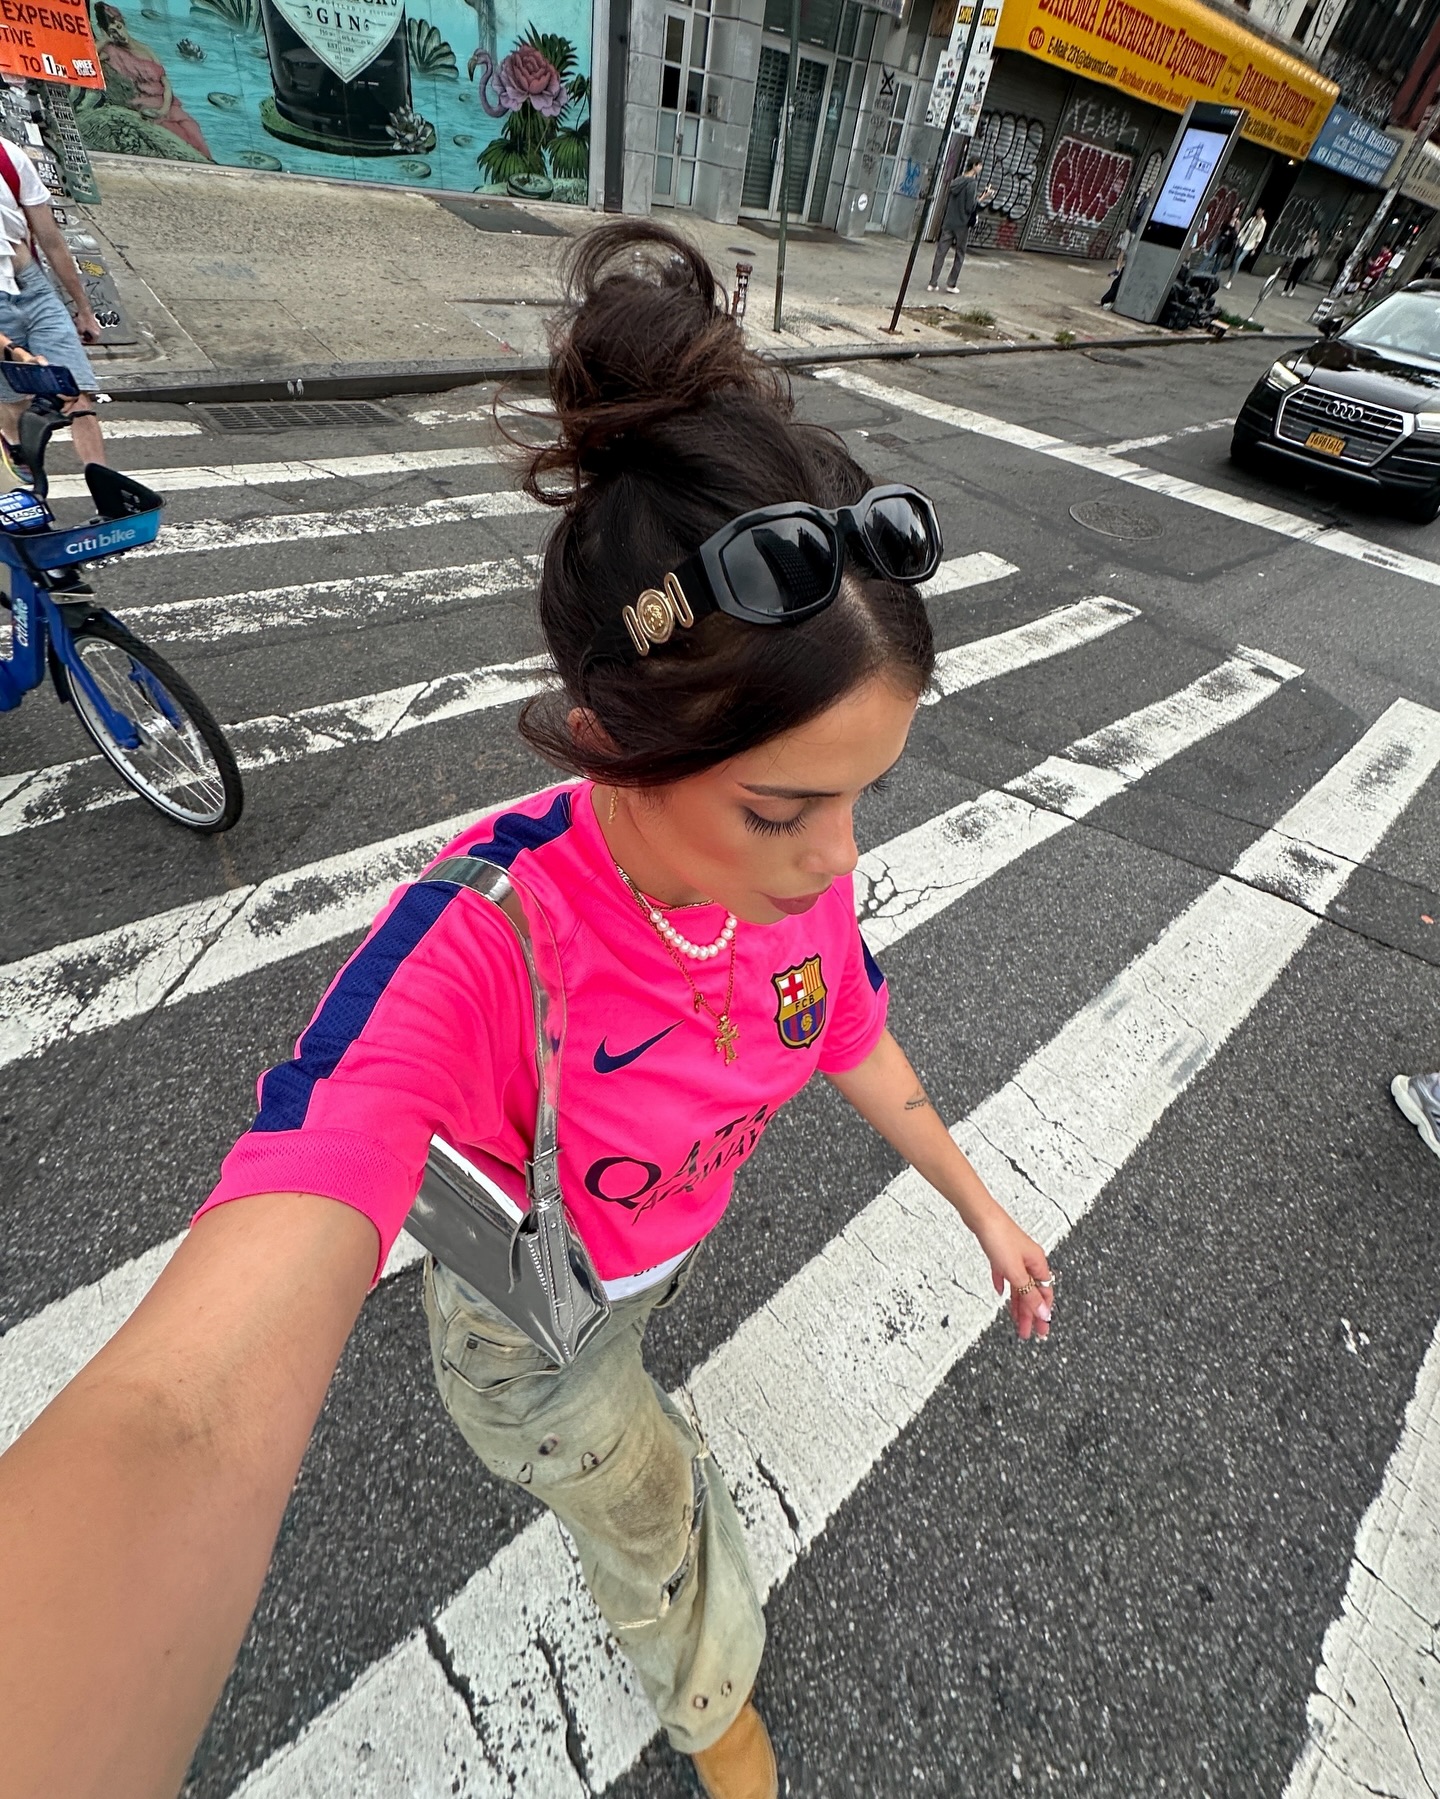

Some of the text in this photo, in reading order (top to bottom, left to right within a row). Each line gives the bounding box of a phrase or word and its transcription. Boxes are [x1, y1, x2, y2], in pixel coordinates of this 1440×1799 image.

[2, 0, 89, 37] EXPENSE
[316, 7, 361, 32] GIN
[0, 26, 36, 48] TIVE
[1038, 0, 1100, 35] AROMA
[1096, 0, 1176, 65] RESTAURANT
[1164, 28, 1229, 90] EQUIPMENT
[19, 54, 41, 73] TO
[48, 88, 68, 99] KING
[1235, 63, 1280, 112] DIAMOND
[1269, 80, 1316, 129] EQUIPMENT
[54, 109, 74, 121] KING
[61, 132, 80, 143] KING
[1348, 120, 1371, 142] CASH
[67, 154, 87, 165] KING
[794, 994, 815, 1012] FCB
